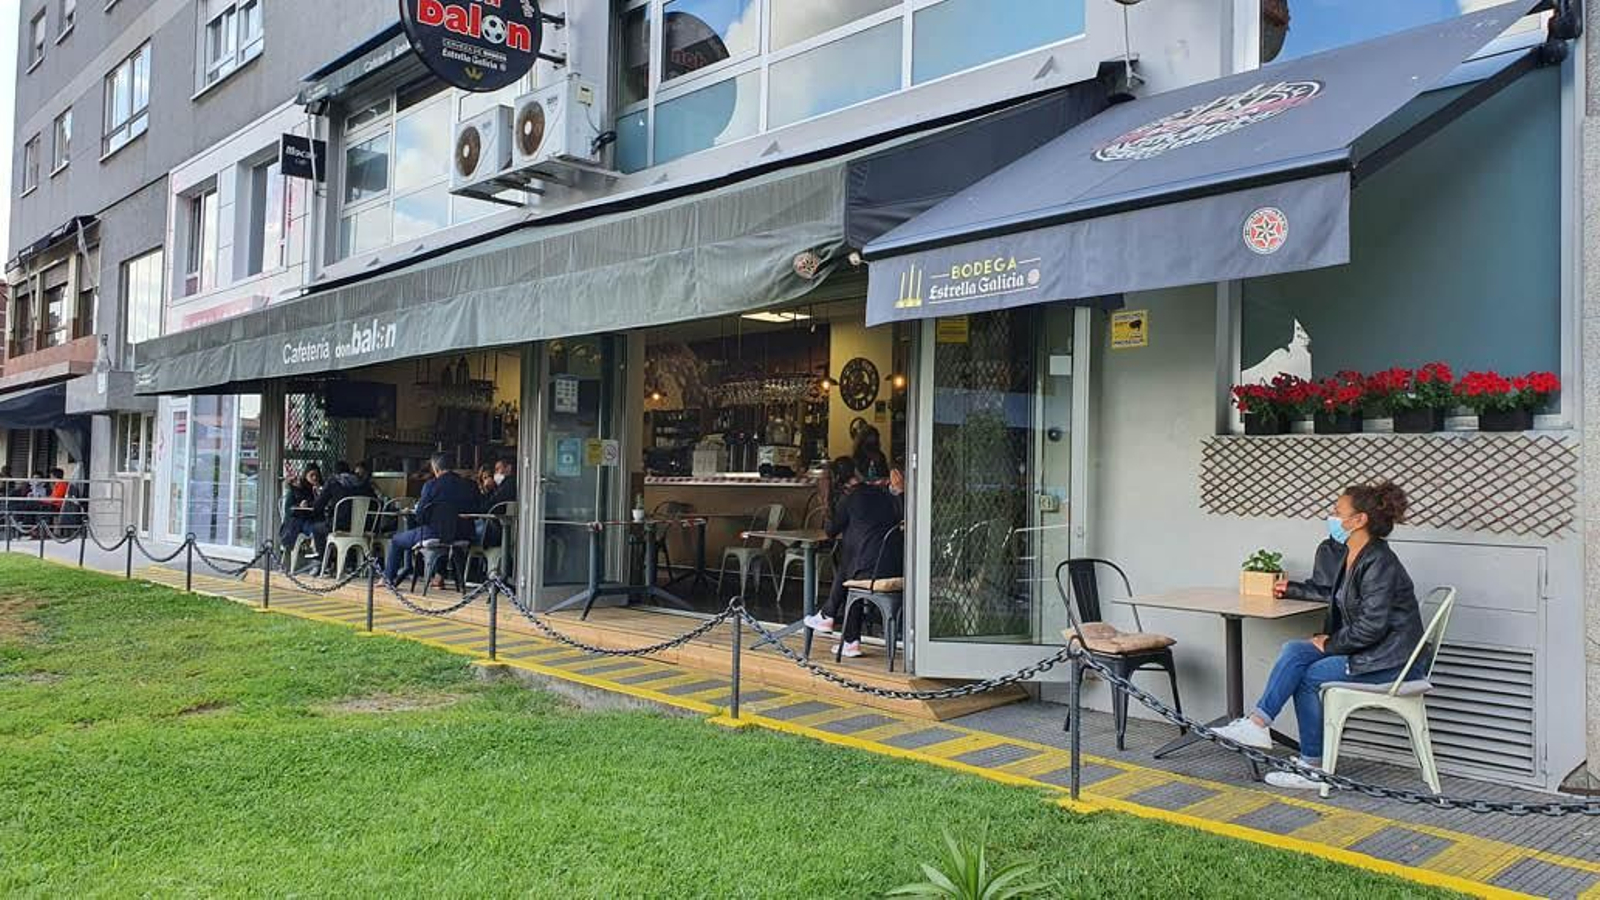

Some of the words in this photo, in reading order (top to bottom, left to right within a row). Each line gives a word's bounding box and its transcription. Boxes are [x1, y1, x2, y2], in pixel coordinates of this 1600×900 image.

[951, 256, 1017, 280] BODEGA
[929, 275, 977, 300] Estrella
[978, 273, 1024, 295] Galicia
